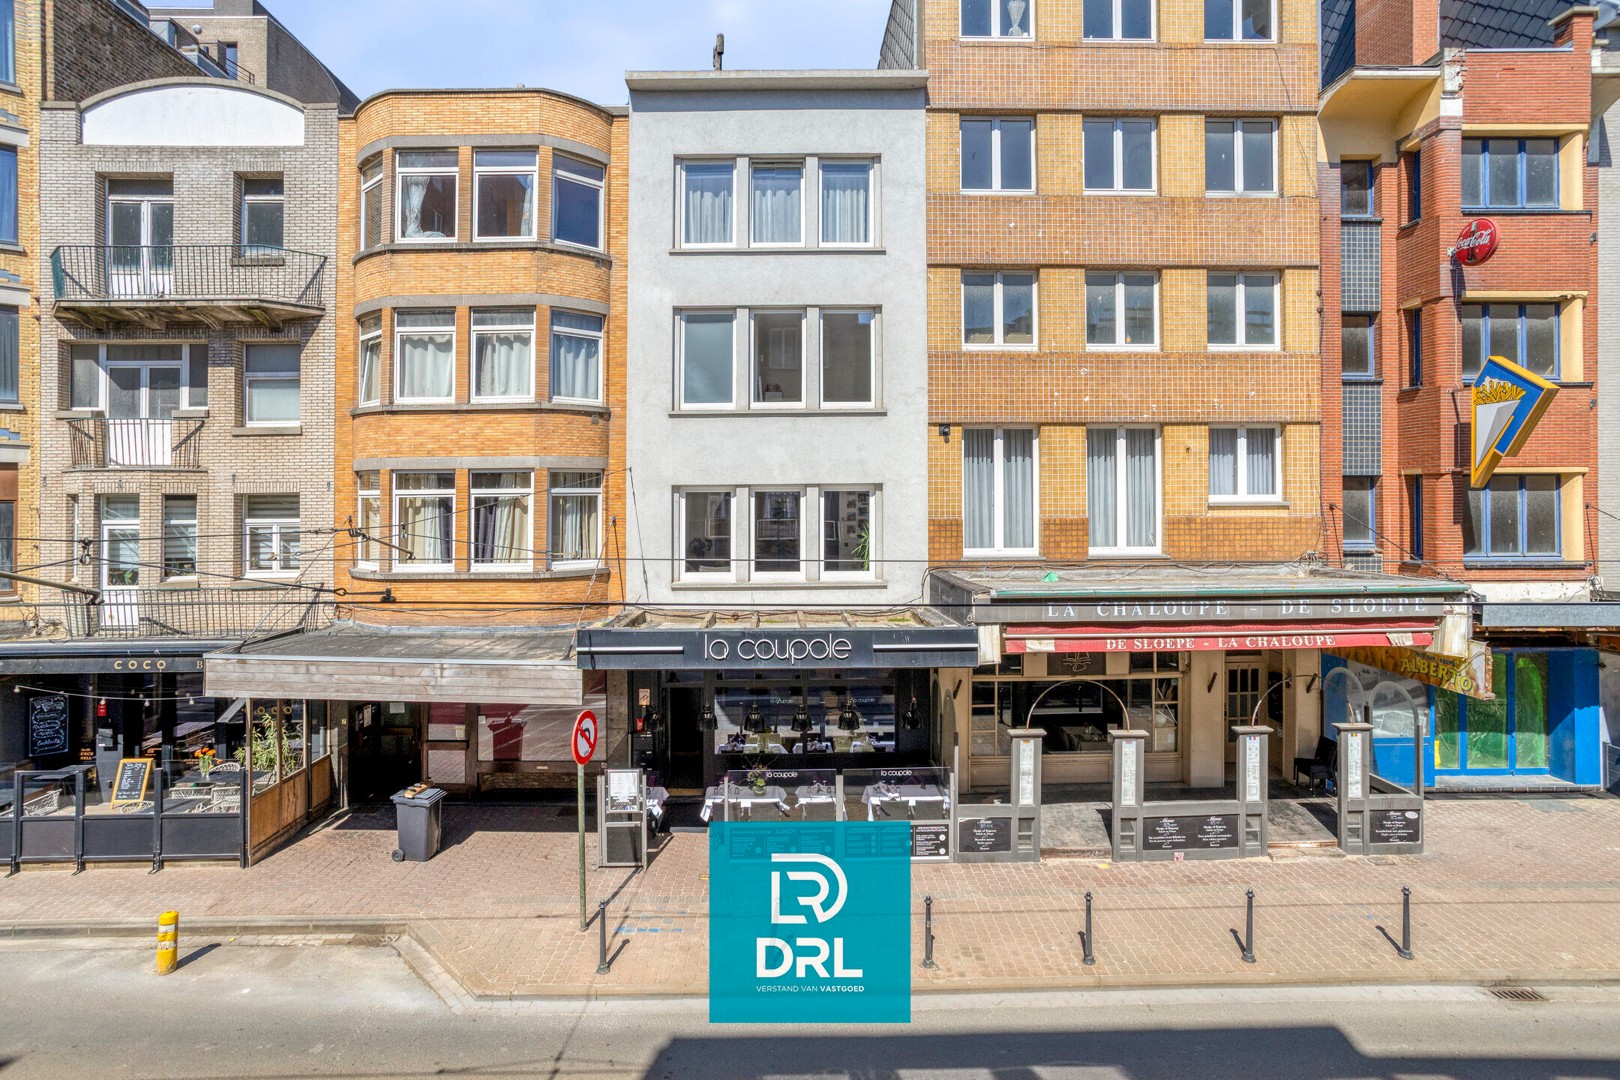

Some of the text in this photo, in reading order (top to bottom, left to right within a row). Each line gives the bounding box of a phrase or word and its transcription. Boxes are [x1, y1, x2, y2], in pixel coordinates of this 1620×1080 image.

[1047, 602, 1076, 617] LA
[1096, 600, 1227, 617] CHALOUPE
[1281, 600, 1311, 615] DE
[1331, 598, 1426, 614] SLOEPE
[704, 633, 852, 665] la coupole
[1106, 639, 1127, 650] DE
[1134, 638, 1195, 650] SLOEPE
[1218, 637, 1238, 648] LA
[1246, 635, 1336, 648] CHALOUPE
[1400, 658, 1473, 692] ALBERTO
[773, 771, 798, 779] coupole
[888, 769, 912, 777] coupole
